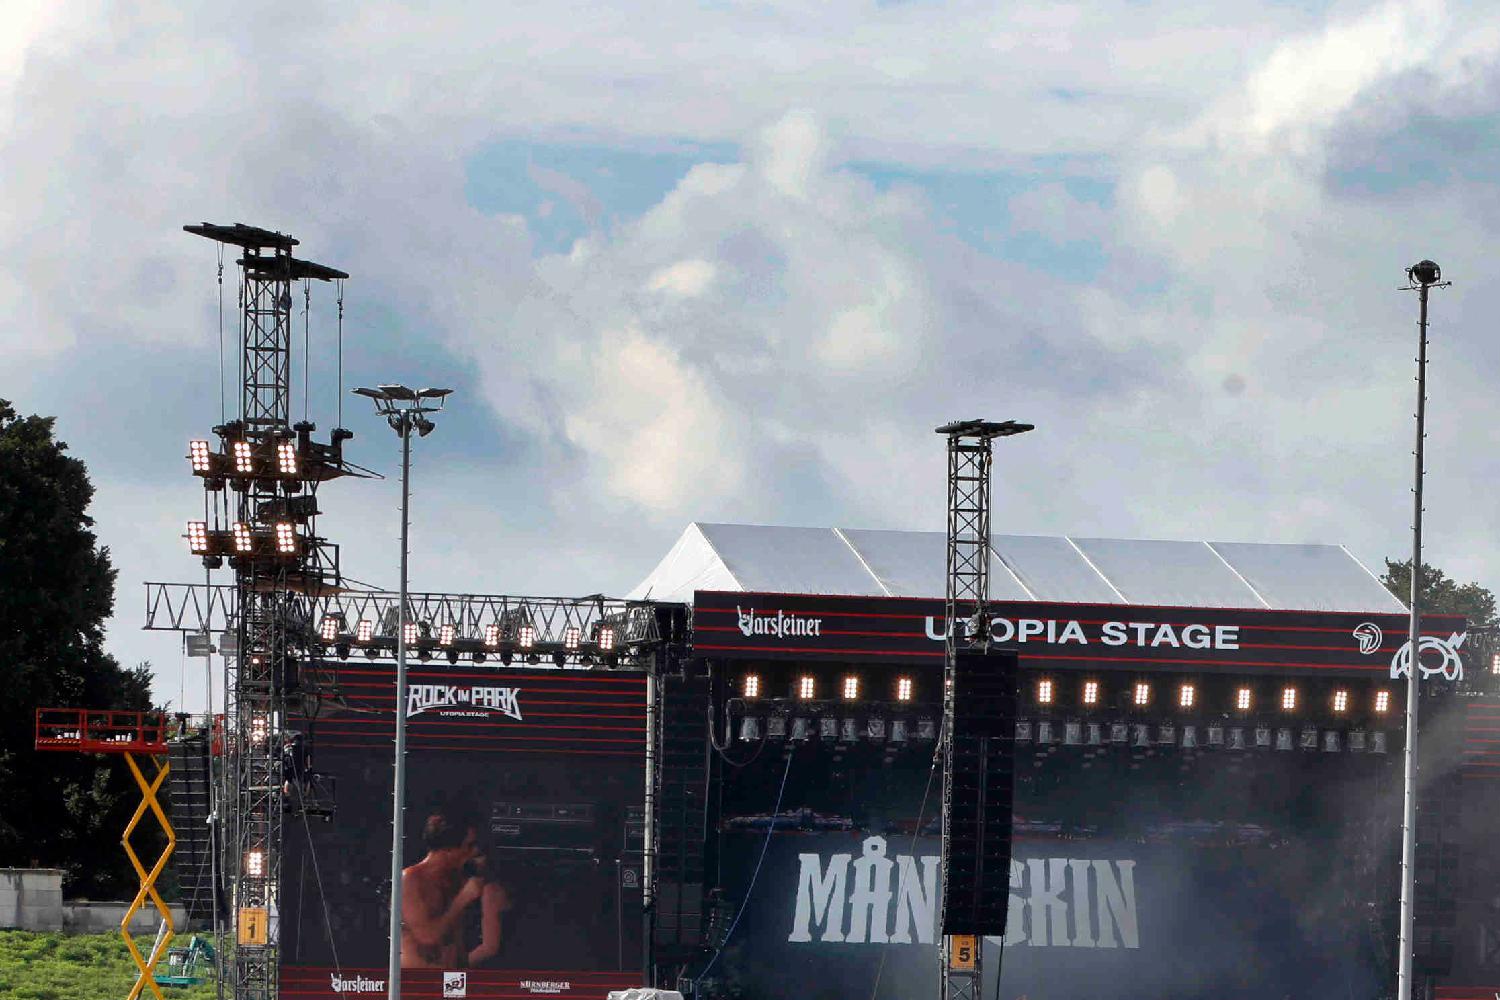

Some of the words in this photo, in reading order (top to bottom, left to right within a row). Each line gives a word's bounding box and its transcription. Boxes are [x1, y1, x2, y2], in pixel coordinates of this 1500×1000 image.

[1101, 621, 1240, 650] STAGE
[407, 684, 458, 718] ROCK
[471, 686, 523, 720] PARK
[788, 835, 1141, 949] MÅNKIN
[959, 947, 970, 963] 5
